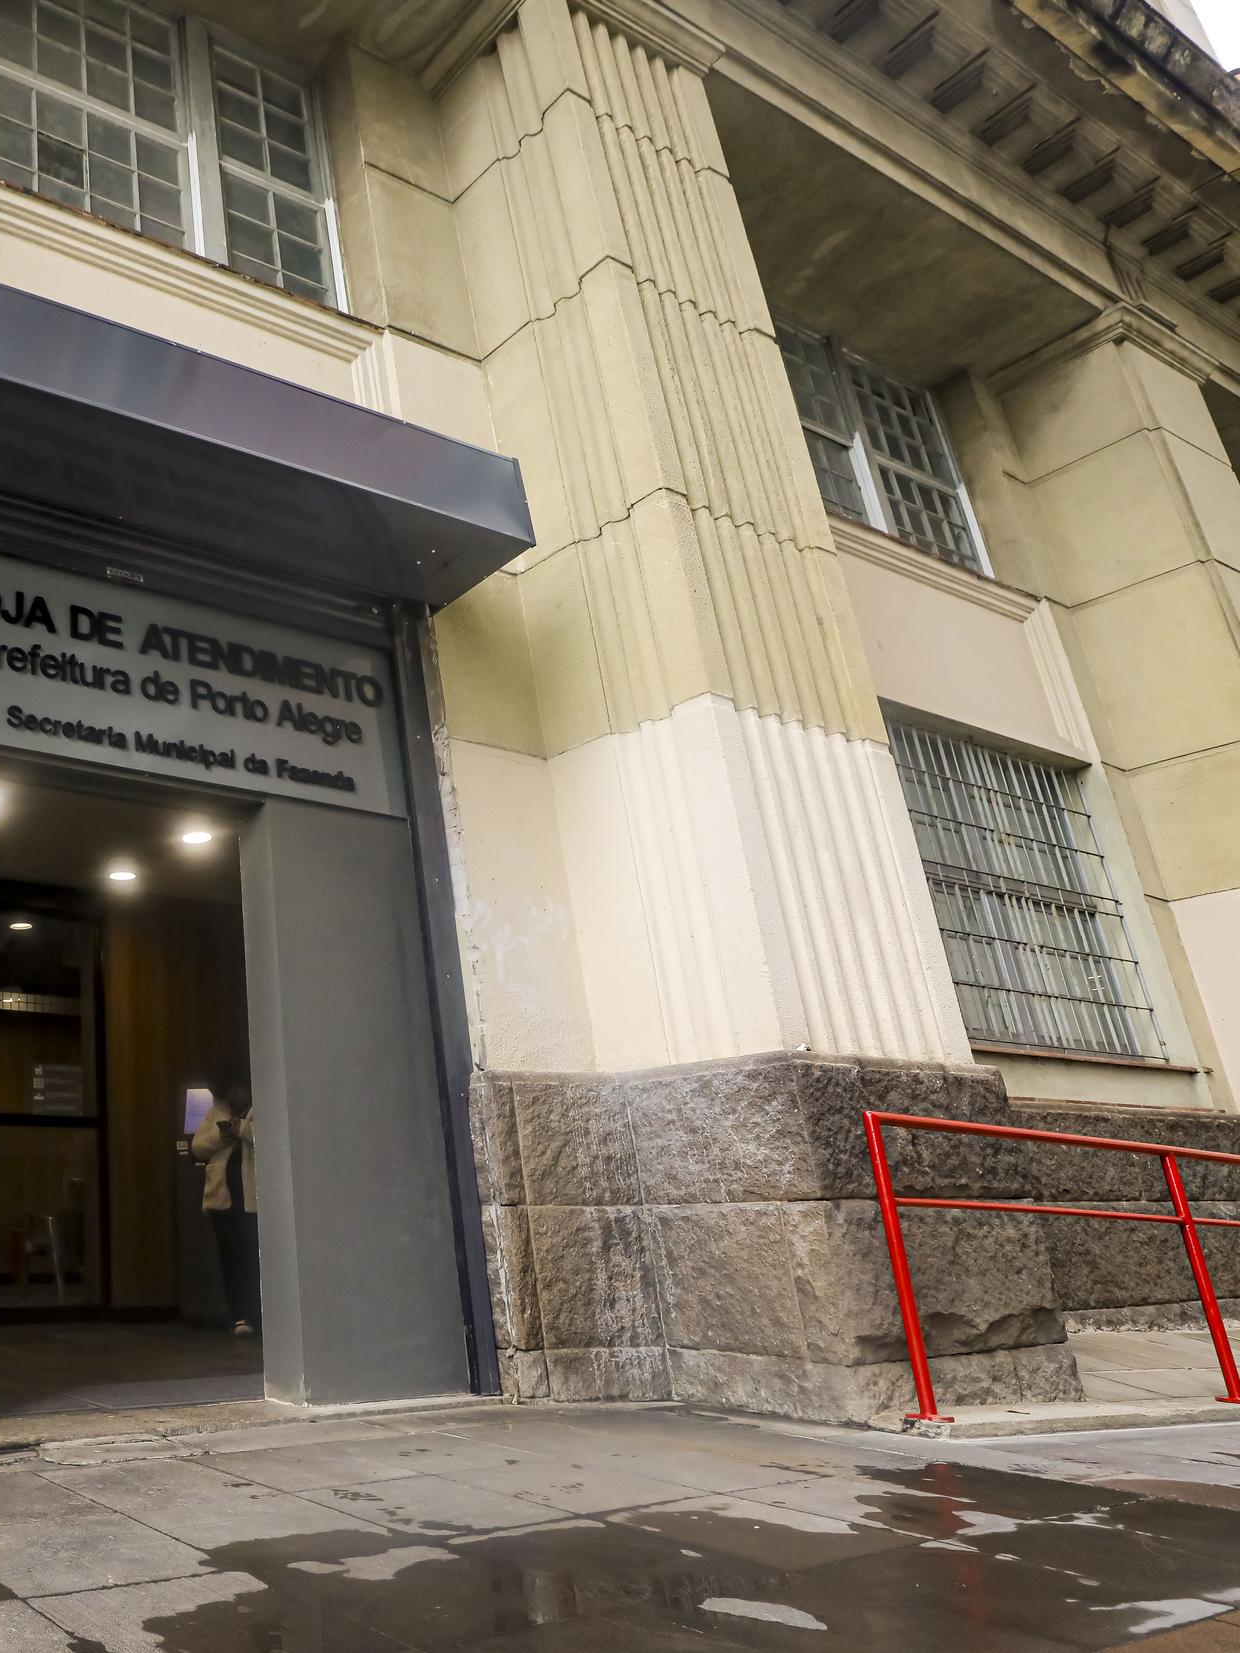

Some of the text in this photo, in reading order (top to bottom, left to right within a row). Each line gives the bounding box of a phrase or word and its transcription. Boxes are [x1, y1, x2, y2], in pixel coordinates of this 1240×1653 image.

[70, 604, 124, 650] DE
[139, 623, 383, 707] ATENDIMENTO
[6, 705, 127, 749] Secretaria
[134, 731, 235, 769] Municipal
[244, 753, 269, 775] da
[141, 670, 180, 705] de
[190, 678, 269, 723] Porto
[276, 699, 362, 745] Alegre
